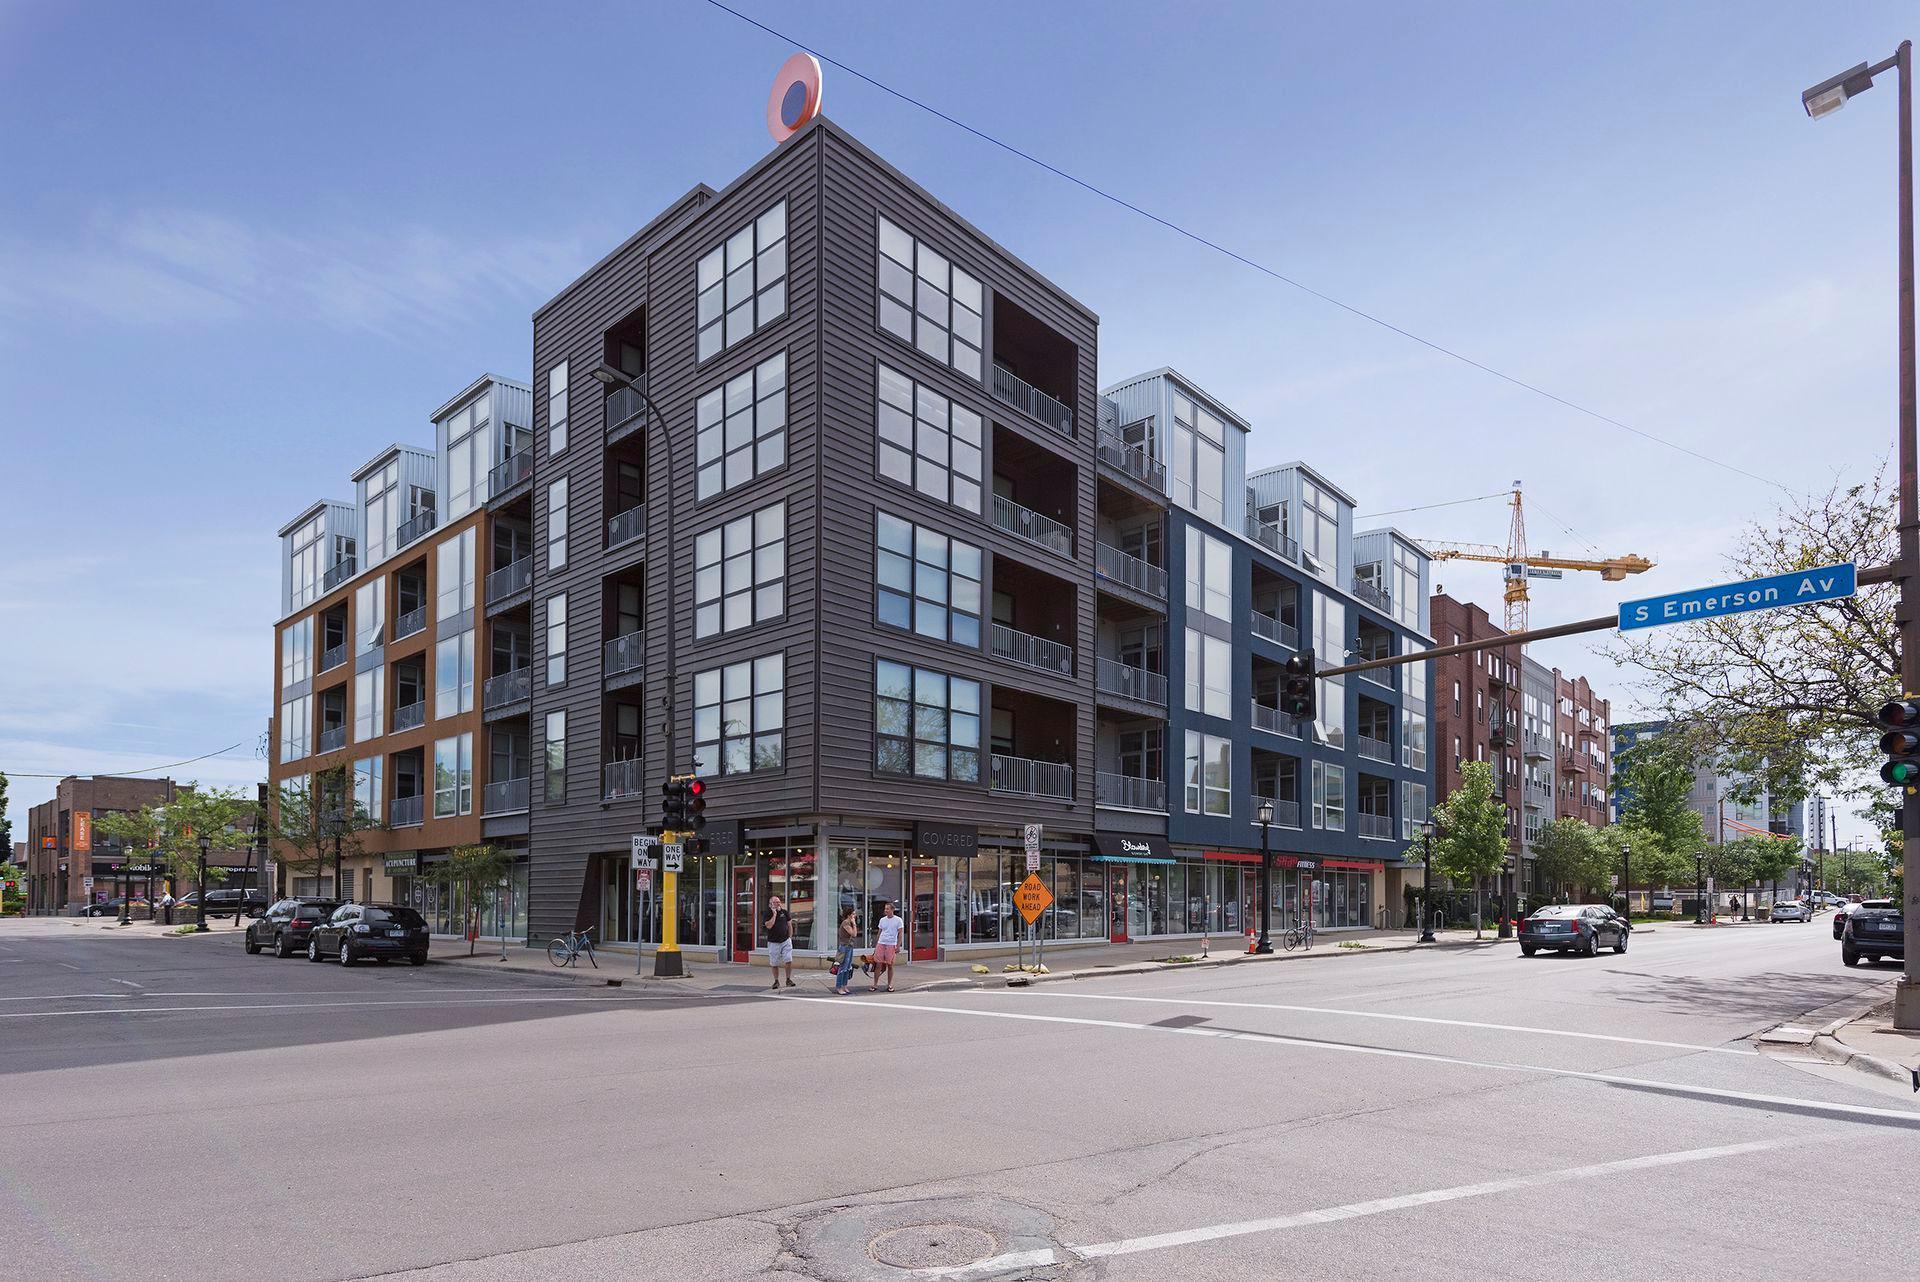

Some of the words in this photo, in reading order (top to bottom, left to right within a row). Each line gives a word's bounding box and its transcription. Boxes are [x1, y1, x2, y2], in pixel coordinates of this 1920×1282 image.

[1635, 606, 1649, 622] S
[1664, 587, 1778, 618] Emerson
[1796, 577, 1835, 597] Av
[634, 838, 656, 847] BEGIN
[922, 831, 974, 847] COVERED
[637, 848, 648, 856] ON
[665, 845, 681, 854] ONE
[385, 858, 416, 868] ACUPUNCTURE
[637, 859, 652, 867] WAY
[1297, 860, 1316, 869] FITNESS
[1023, 883, 1041, 891] ROAD
[1020, 903, 1041, 911] AHEAD
